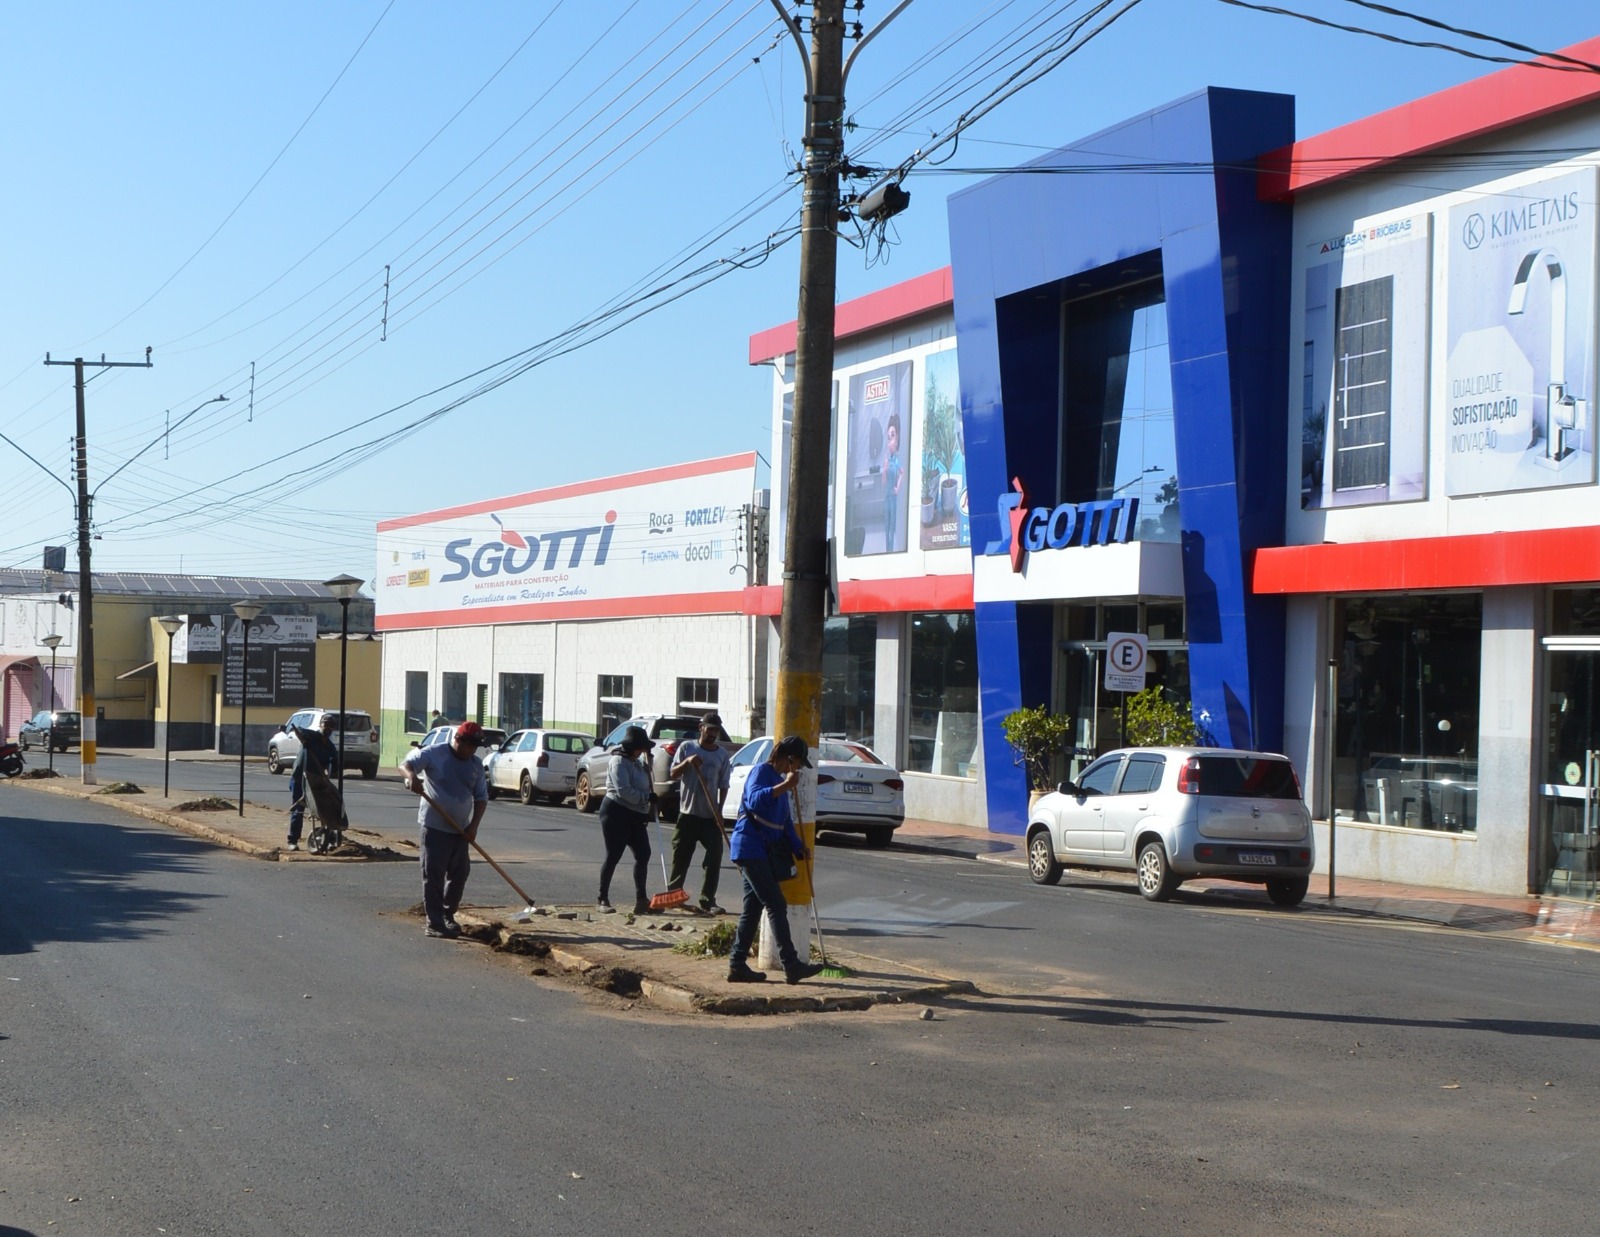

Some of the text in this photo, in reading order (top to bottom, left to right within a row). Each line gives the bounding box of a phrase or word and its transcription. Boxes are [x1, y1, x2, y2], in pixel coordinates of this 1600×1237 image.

[1491, 191, 1578, 239] KIMETAIS
[1376, 220, 1411, 238] RIOBRAS
[1330, 233, 1362, 251] LUCASA
[866, 381, 888, 399] ASTRA
[1453, 372, 1502, 398] QUALIDADE
[1453, 396, 1517, 425] SOFISTICAÇÃO
[1452, 428, 1496, 454] INOVAÇÃO
[649, 512, 673, 527] Roca
[685, 506, 725, 527] FORTLEV
[942, 522, 958, 532] VASOS
[648, 550, 679, 562] TRAMONTINA
[685, 539, 712, 562] docol
[475, 574, 569, 590] MATERIAIS PARA CONSTRUÇÃO
[462, 595, 504, 606] Especialista
[520, 589, 555, 601] Realizar
[557, 586, 587, 597] Sonhos
[1122, 646, 1133, 665] E
